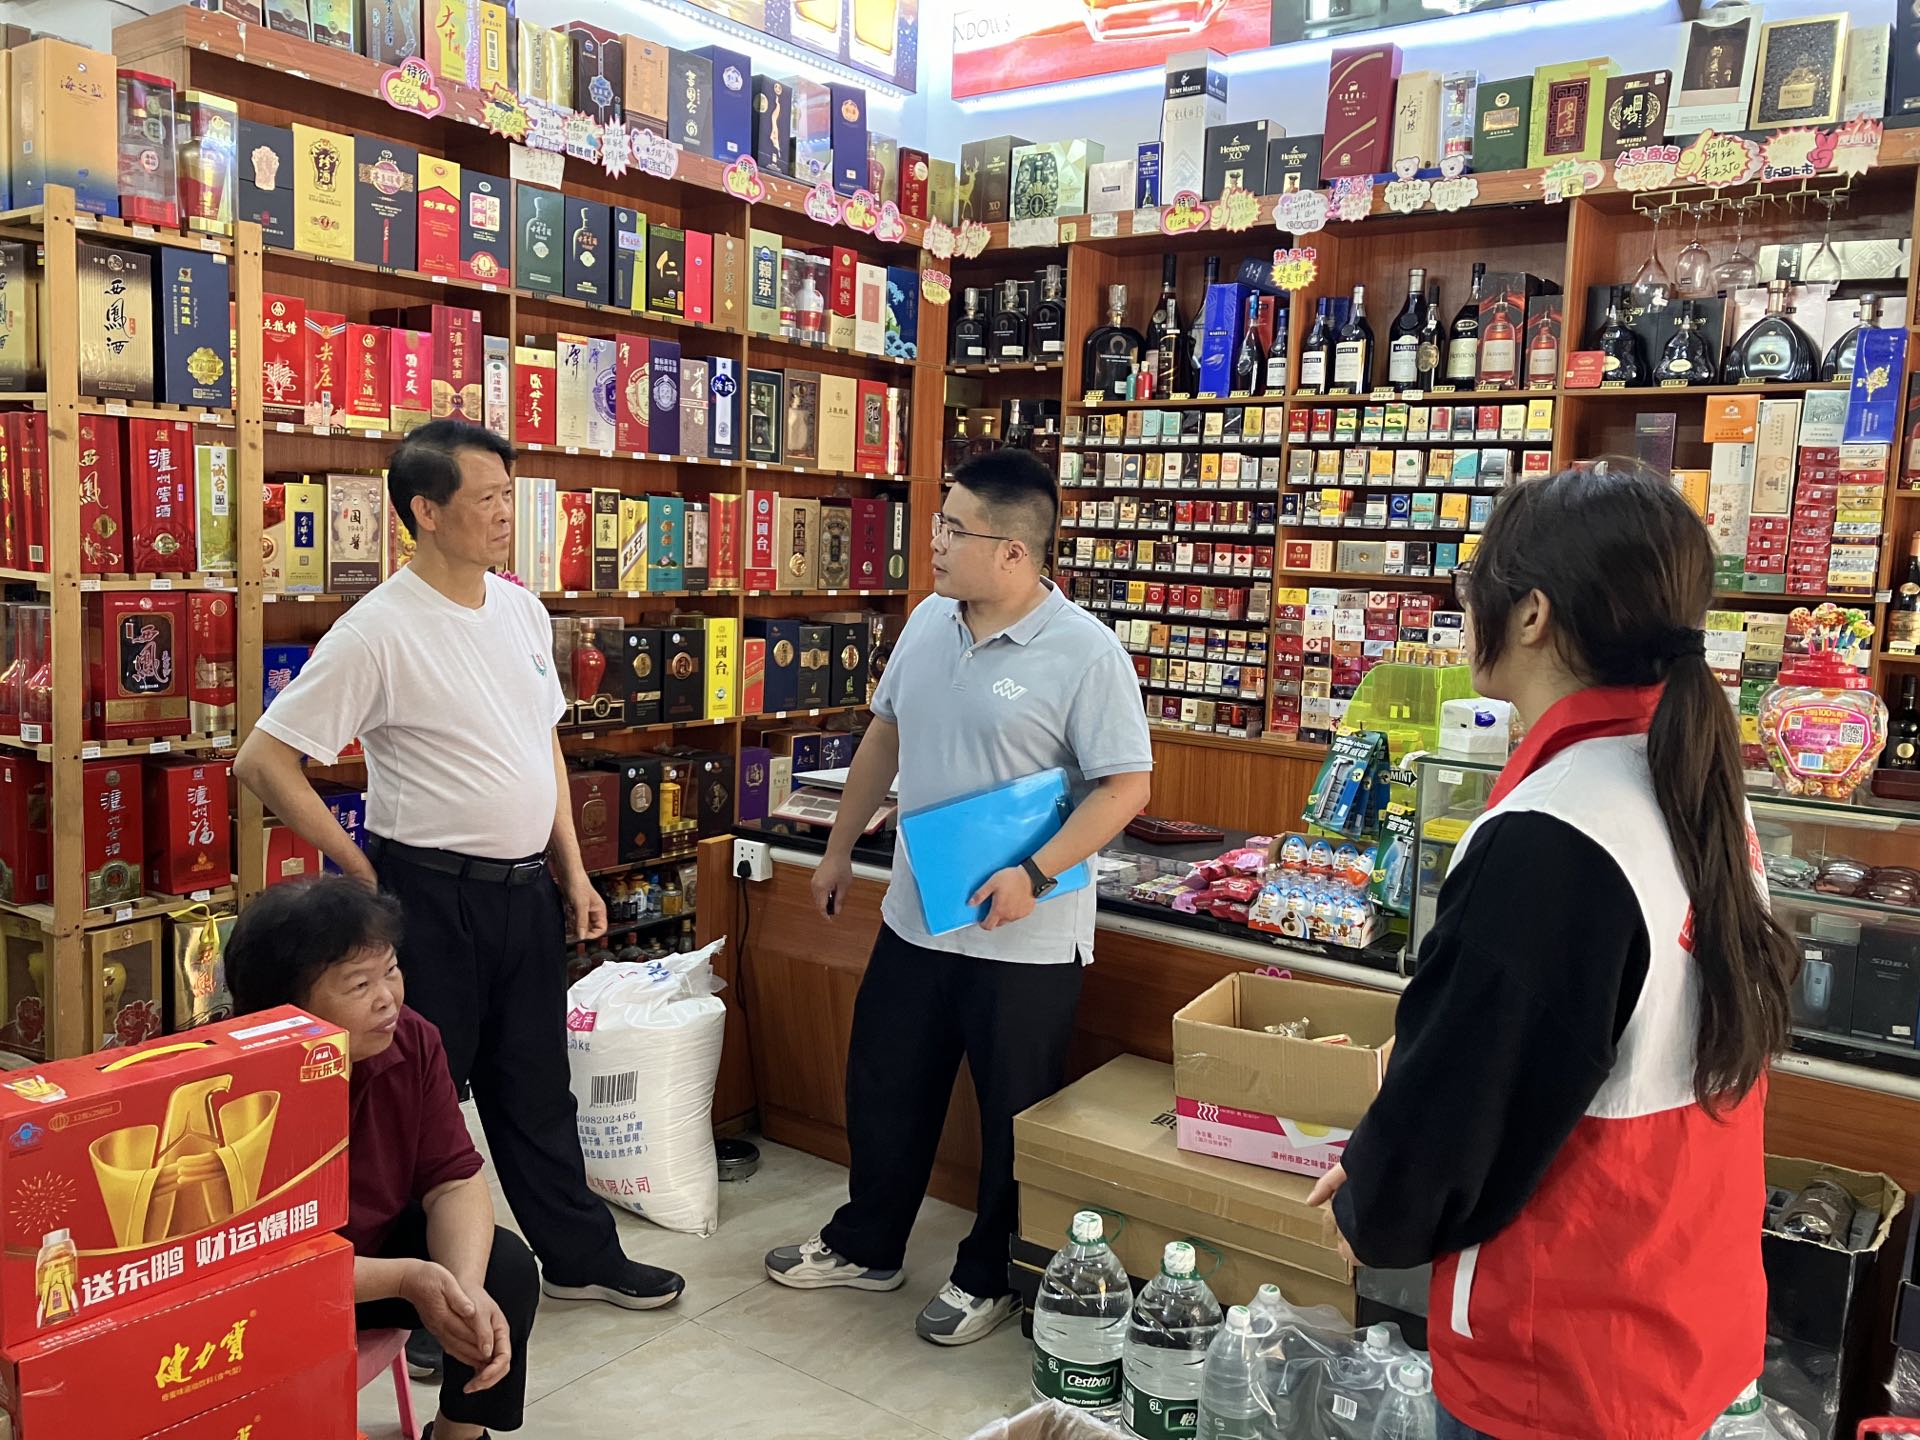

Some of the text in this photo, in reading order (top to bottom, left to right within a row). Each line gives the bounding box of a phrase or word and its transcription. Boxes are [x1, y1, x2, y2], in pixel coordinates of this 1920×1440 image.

[405, 64, 429, 83] 特价
[1220, 144, 1251, 155] Hennessy
[1281, 152, 1308, 161] Hennessy
[1764, 163, 1813, 178] 新品上市
[835, 327, 855, 337] 1573
[1759, 353, 1779, 366] XO
[715, 645, 728, 675] 國台
[1390, 770, 1412, 784] MINT
[82, 1200, 318, 1307] 送东鹏 财运爆鹏
[1067, 1373, 1111, 1388] Cestbon
